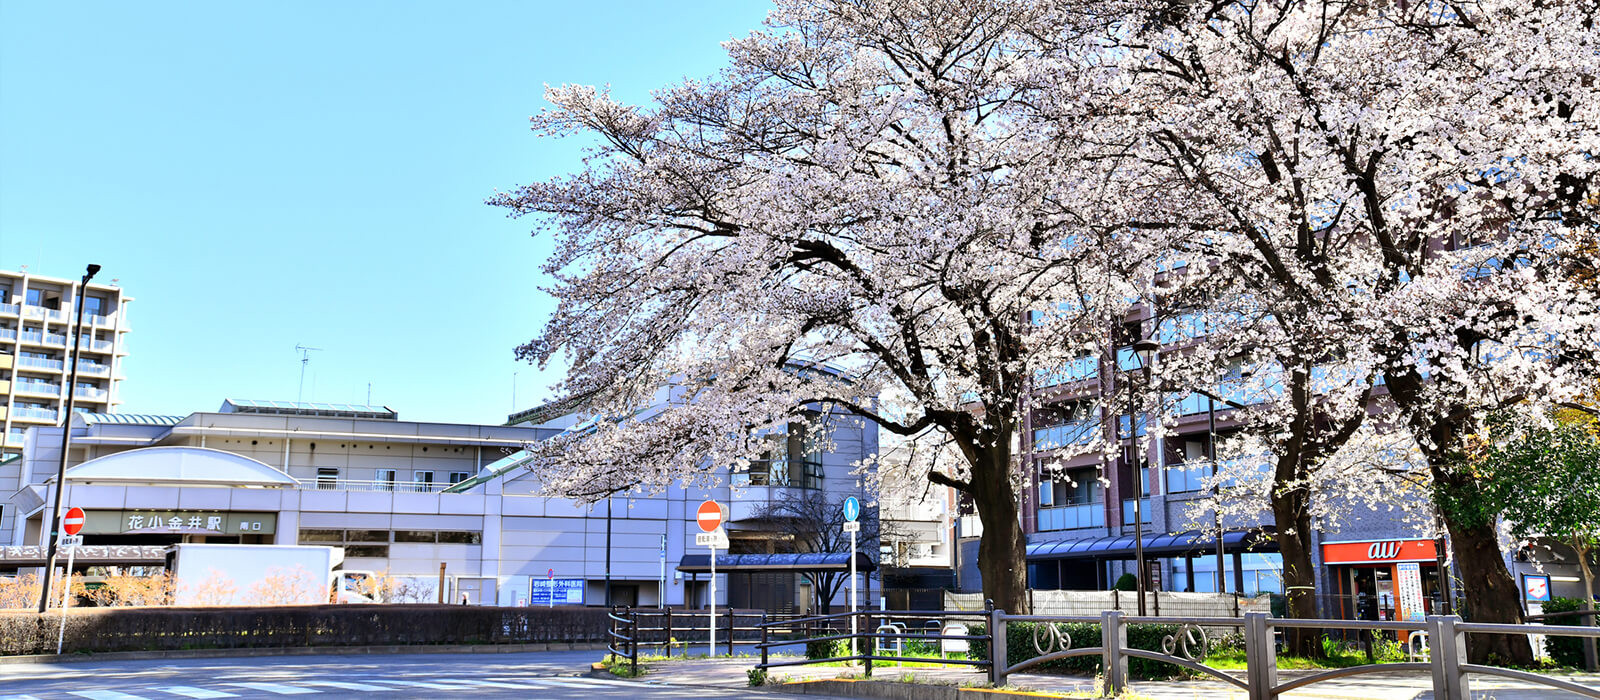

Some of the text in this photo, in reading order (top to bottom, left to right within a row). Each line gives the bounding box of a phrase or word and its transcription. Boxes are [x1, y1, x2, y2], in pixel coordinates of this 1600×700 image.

[128, 515, 261, 531] 花小金井駅 南口
[1368, 541, 1400, 559] au
